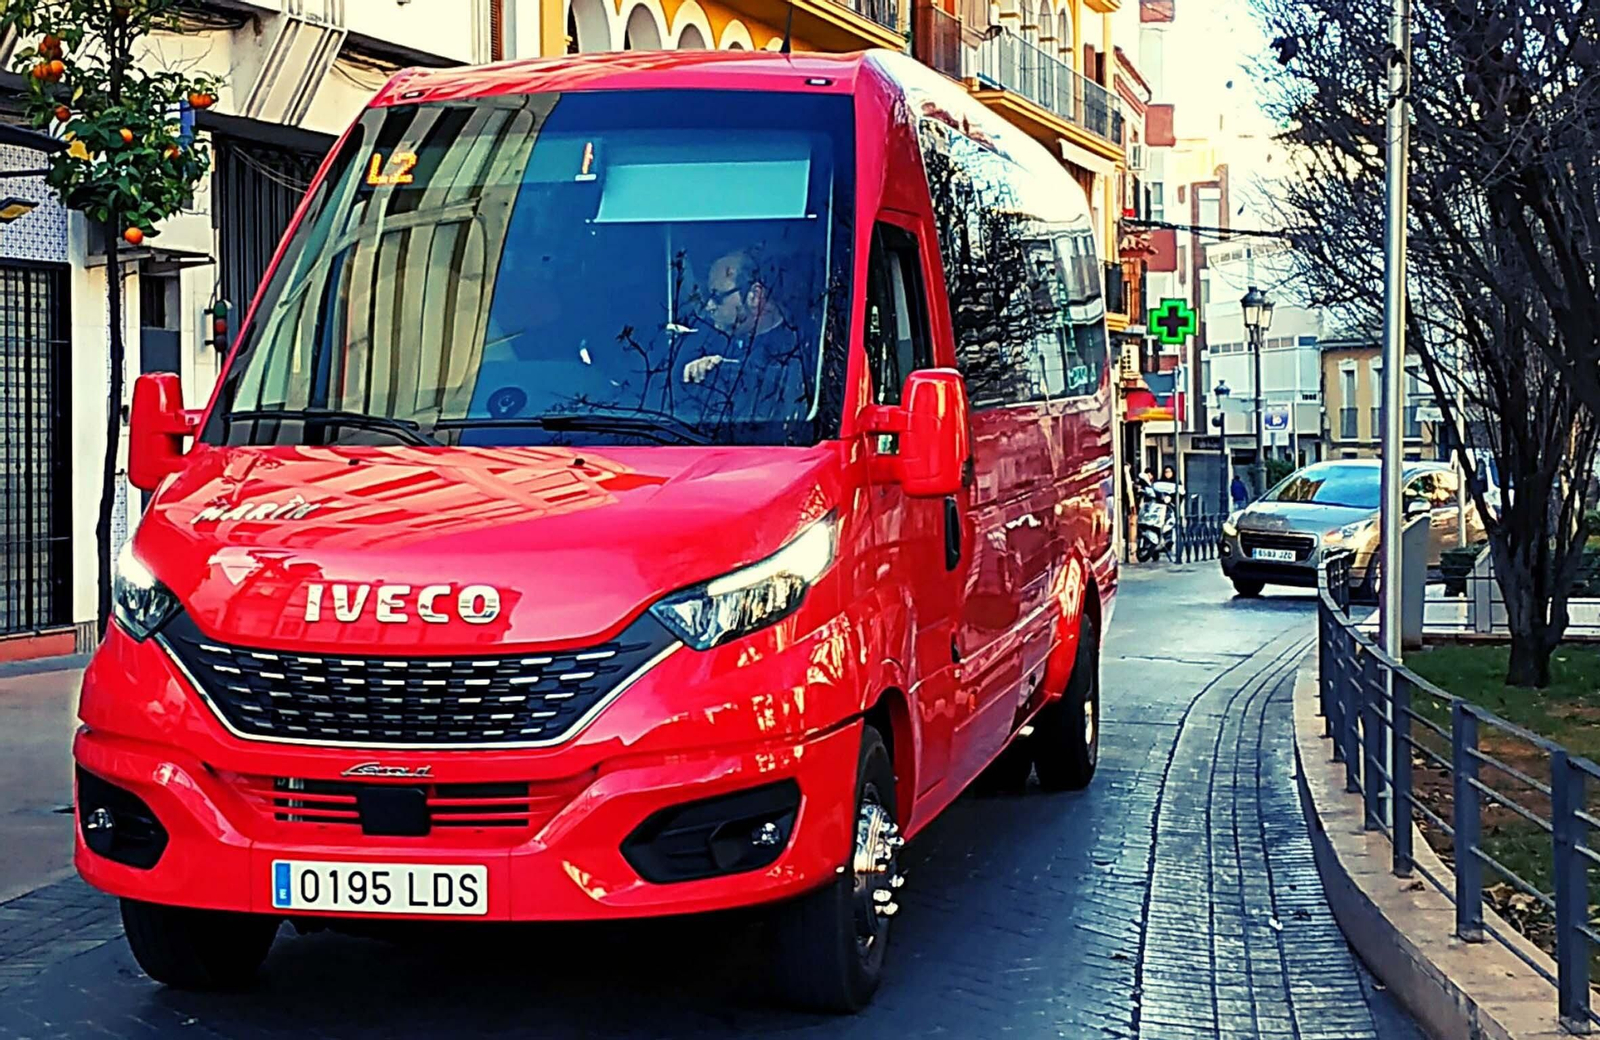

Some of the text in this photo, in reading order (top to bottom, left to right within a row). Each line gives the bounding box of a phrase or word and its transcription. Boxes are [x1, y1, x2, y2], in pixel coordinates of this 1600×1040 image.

[367, 152, 418, 184] L2
[304, 584, 500, 623] IVECO
[279, 888, 287, 899] E
[300, 869, 479, 908] 0195 LDS
